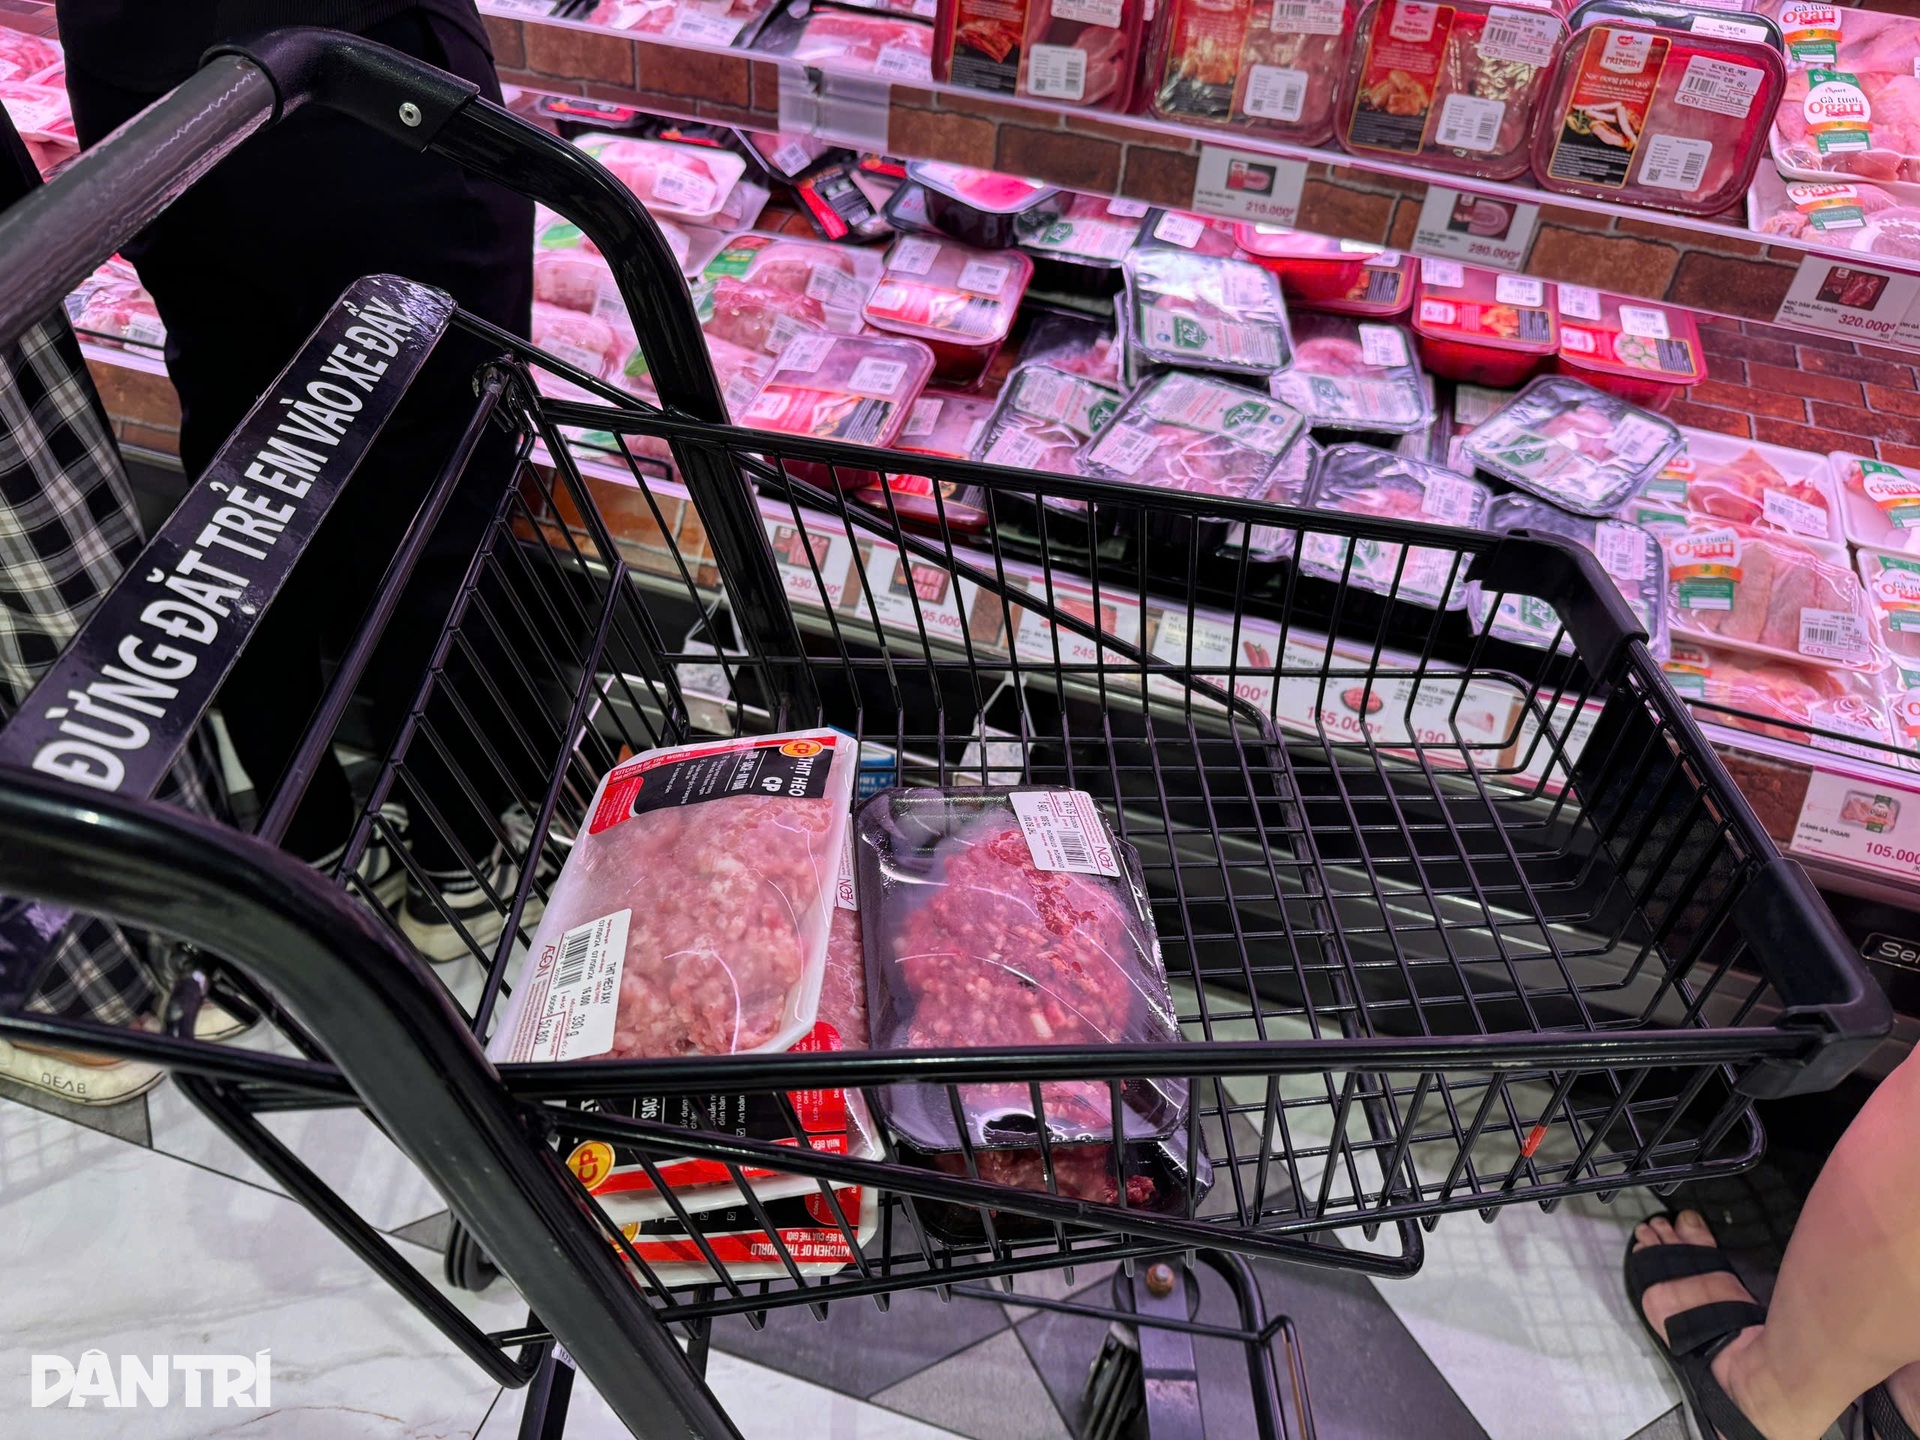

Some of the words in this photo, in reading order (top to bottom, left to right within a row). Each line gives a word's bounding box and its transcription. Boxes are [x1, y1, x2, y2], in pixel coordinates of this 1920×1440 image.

[1782, 10, 1836, 25] Ogari
[1808, 102, 1865, 118] Ogari
[342, 296, 411, 358] ĐẨY
[320, 343, 389, 393] XE
[280, 380, 363, 447] VÀO
[244, 425, 329, 499] EM
[196, 481, 297, 560] TRẺ
[141, 549, 256, 646] ĐẶT
[33, 634, 197, 792] ĐỪNG
[790, 742, 812, 755] CP
[614, 763, 642, 777] KITCHEN
[653, 756, 665, 765] THE
[666, 751, 691, 762] WORLD
[790, 757, 815, 780] THỊT
[762, 776, 784, 793] CP
[787, 778, 808, 798] HEO
[602, 977, 614, 993] HEO
[600, 992, 611, 1005] XAY
[573, 1012, 586, 1030] 330
[640, 1097, 661, 1119] SẠC
[737, 1095, 746, 1112] toàn
[737, 1113, 746, 1124] An
[577, 1148, 599, 1184] CP
[800, 1244, 812, 1257] OF
[813, 1244, 851, 1257] KITCHEN
